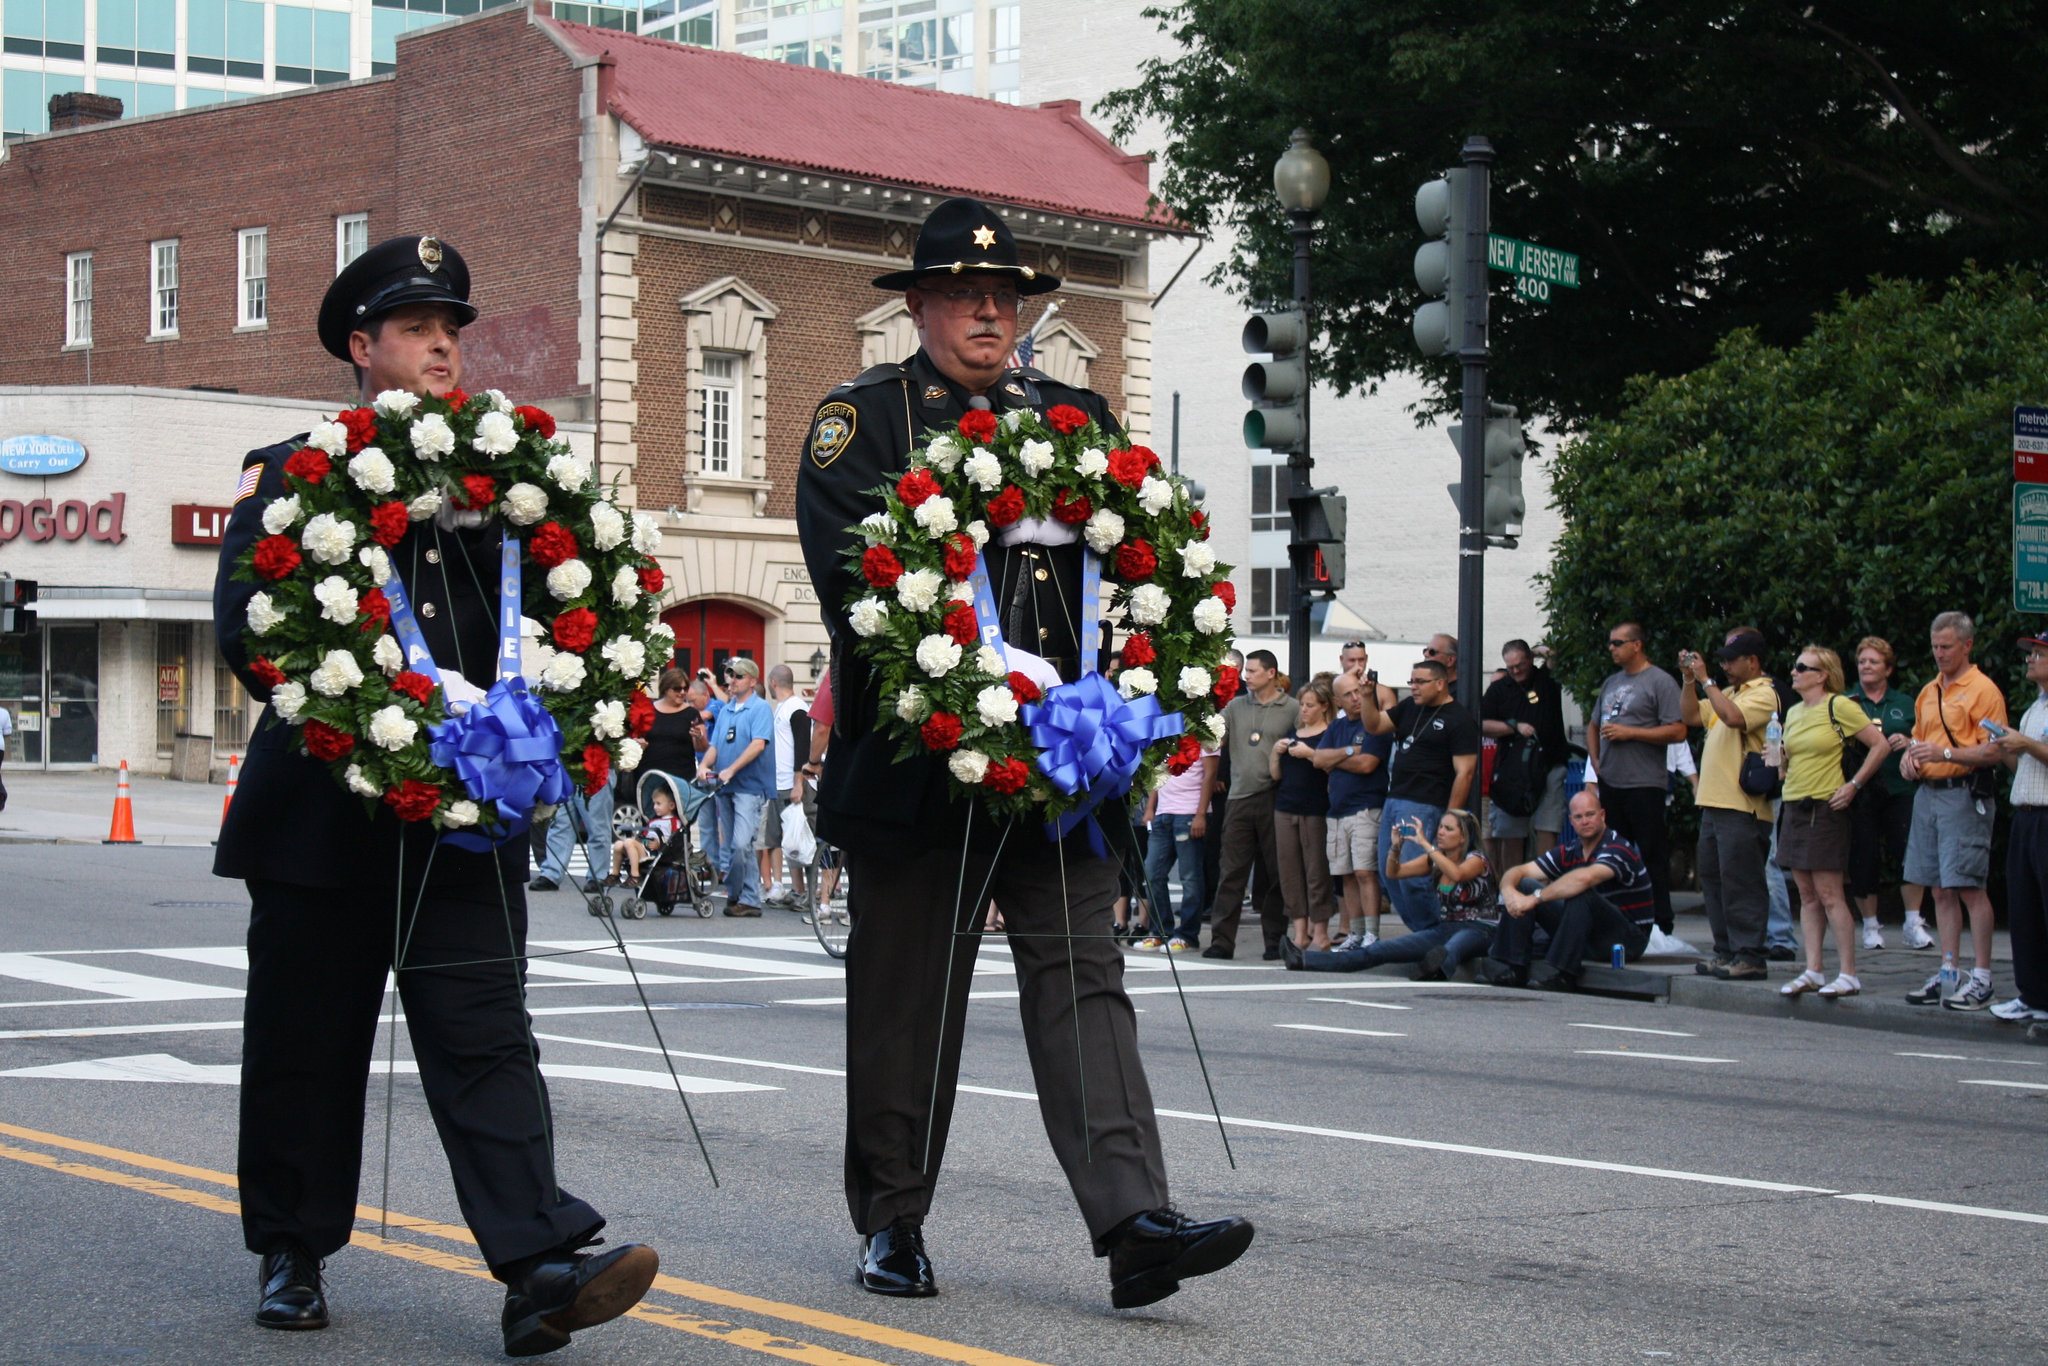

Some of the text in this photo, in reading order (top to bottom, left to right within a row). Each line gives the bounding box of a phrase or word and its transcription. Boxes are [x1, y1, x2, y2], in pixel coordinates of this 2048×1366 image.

[1488, 237, 1576, 281] NEW JERSEY AV
[1564, 270, 1576, 285] NW
[1517, 276, 1549, 300] 400
[818, 406, 853, 421] SHERIFF
[2, 443, 26, 457] NEW
[28, 443, 57, 456] YORK
[2018, 439, 2048, 450] 202-637-
[8, 457, 69, 469] Carry Out
